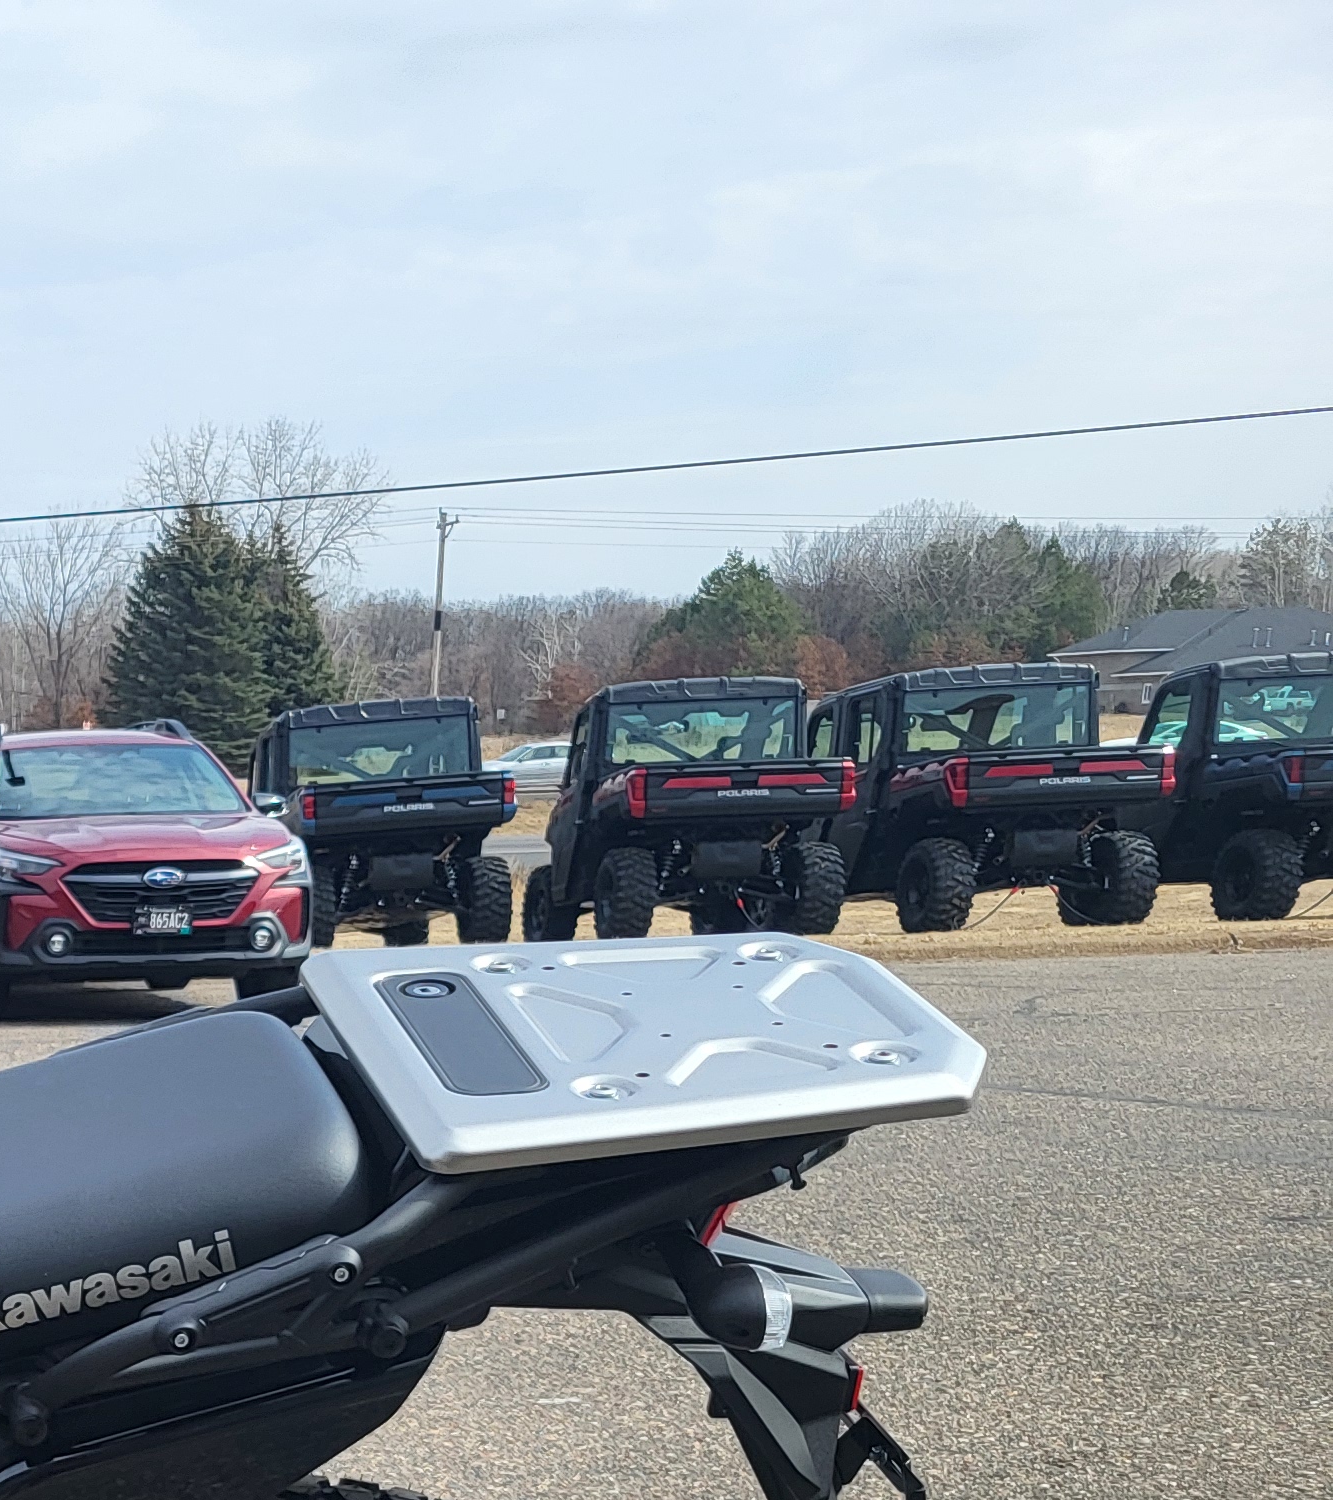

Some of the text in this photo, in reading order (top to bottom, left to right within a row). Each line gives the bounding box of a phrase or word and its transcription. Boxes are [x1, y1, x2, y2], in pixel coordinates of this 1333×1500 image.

[1039, 776, 1092, 786] POLARIS
[717, 788, 770, 798] POLARIS
[383, 802, 436, 813] POLARIS
